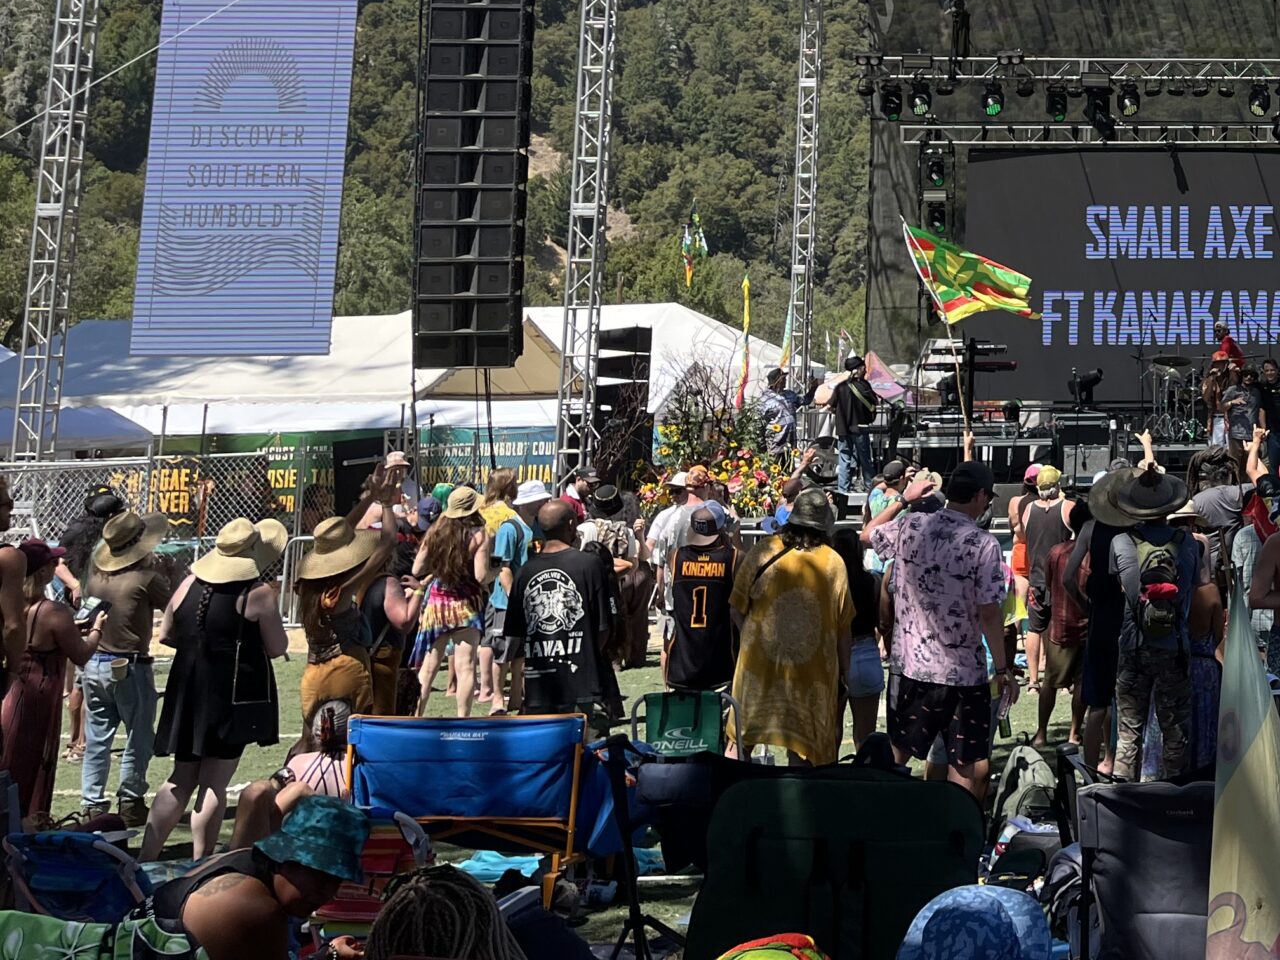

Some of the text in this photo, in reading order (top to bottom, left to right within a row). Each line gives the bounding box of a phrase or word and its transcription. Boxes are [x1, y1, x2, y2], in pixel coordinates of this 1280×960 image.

[189, 124, 305, 147] DISCOVER
[186, 163, 301, 188] SOUTHERN
[182, 203, 298, 228] HUMBOLDT
[1085, 205, 1274, 259] SMALL AXE
[1041, 290, 1084, 346] FT
[532, 441, 556, 456] COU
[128, 468, 190, 492] RGGAE
[681, 561, 726, 577] KINGMAN
[690, 586, 707, 628] 1
